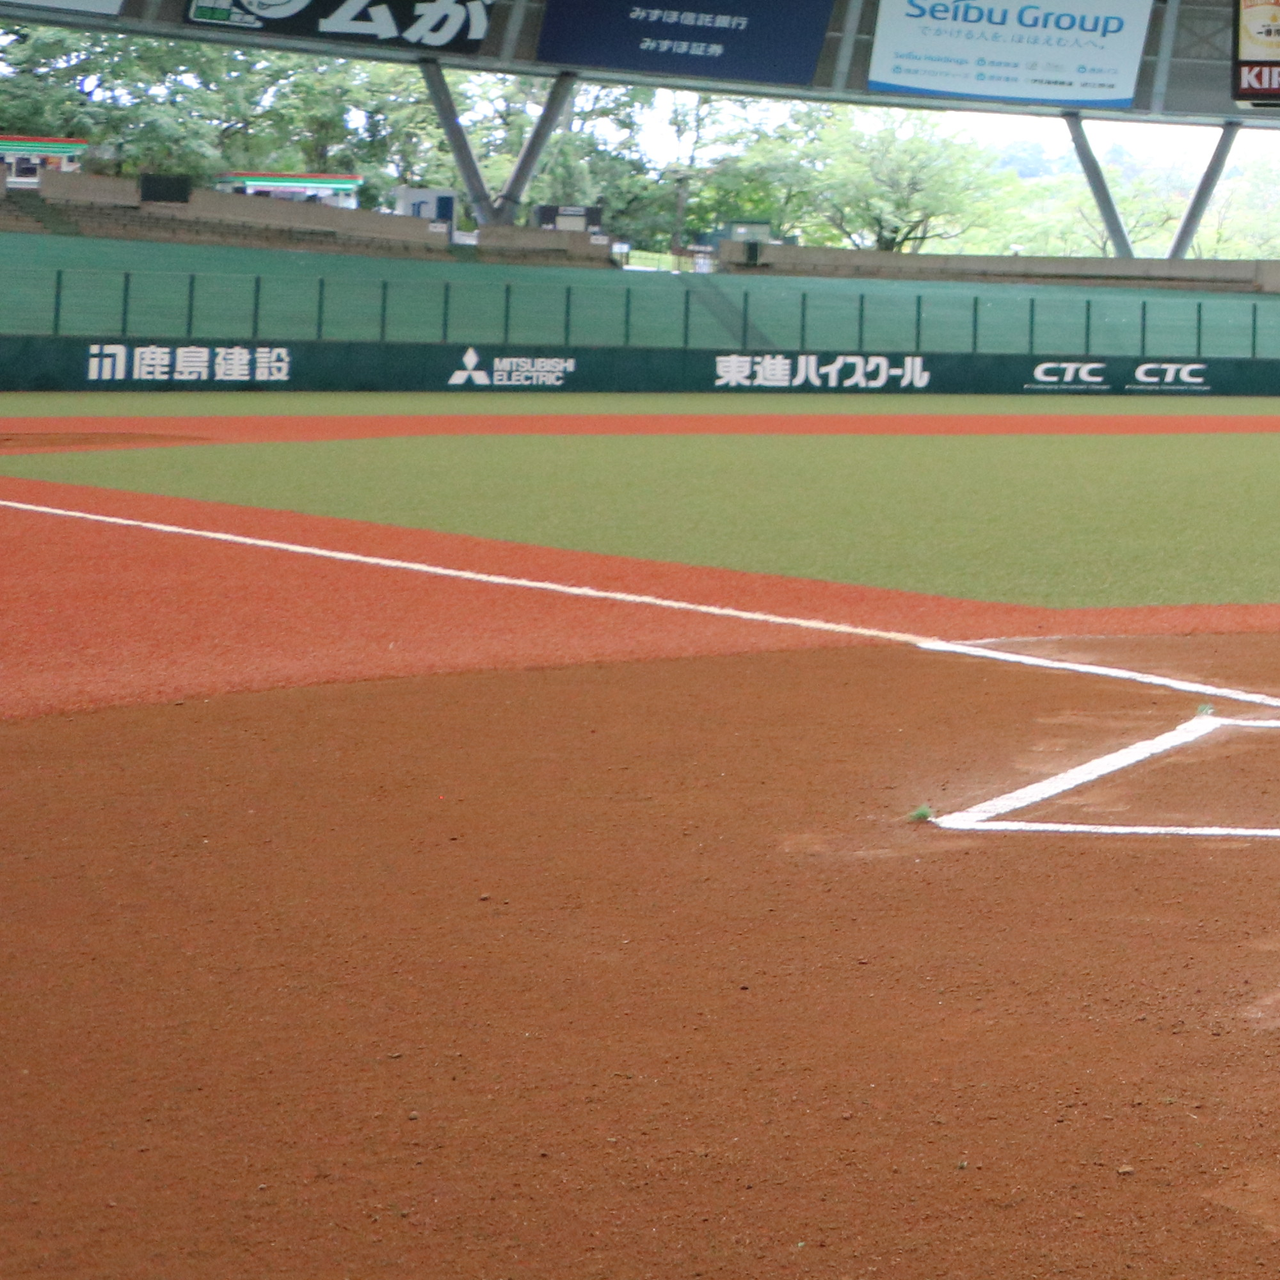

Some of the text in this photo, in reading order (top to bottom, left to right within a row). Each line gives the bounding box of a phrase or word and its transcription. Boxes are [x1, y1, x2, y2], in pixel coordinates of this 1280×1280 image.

[629, 6, 749, 30] みずほ信託銀行
[1016, 5, 1125, 38] Group
[639, 37, 725, 57] みずほ証券
[133, 345, 291, 381] 鹿島建設
[493, 357, 575, 372] MITSUBISHI
[715, 355, 930, 388] 東進ハイスクール
[1033, 362, 1107, 382] CTC
[1134, 363, 1208, 383] CTC
[493, 371, 565, 386] ELECTRIC
